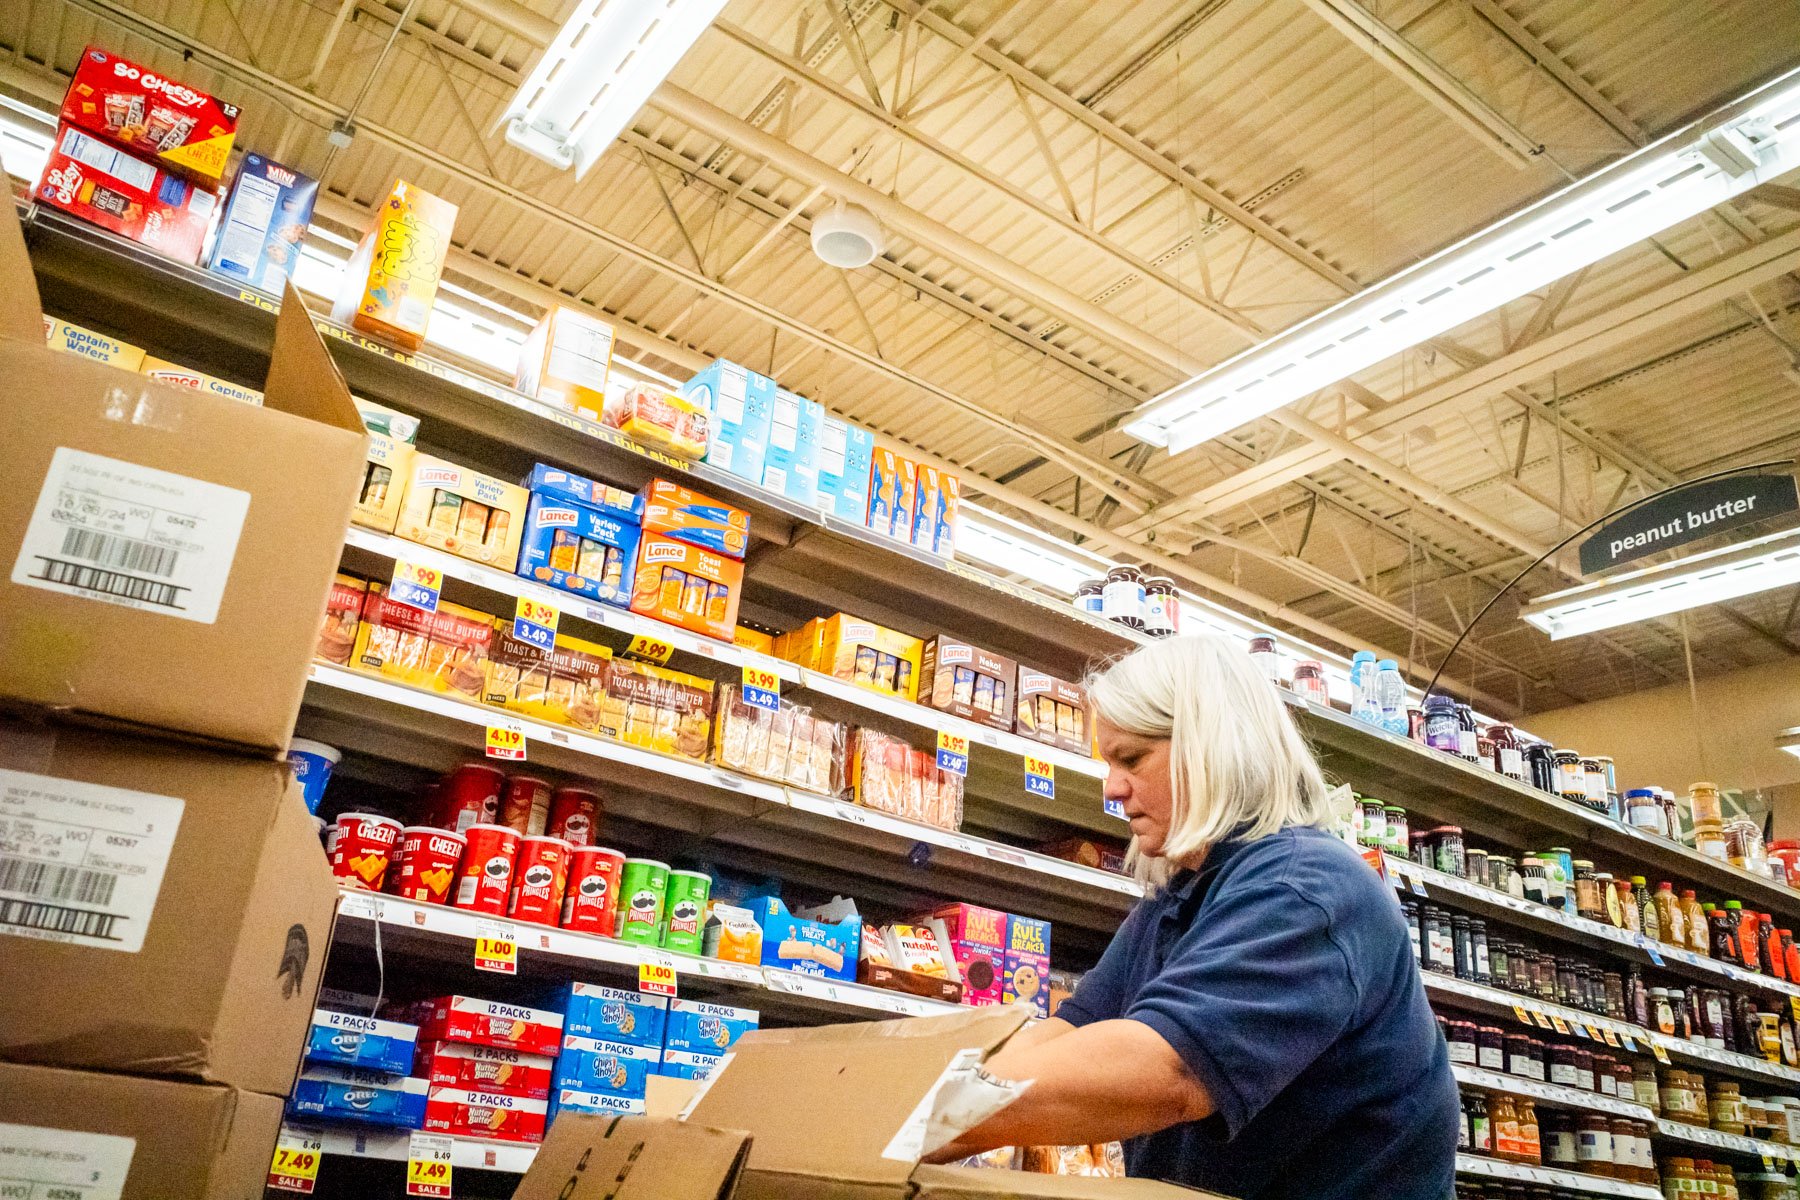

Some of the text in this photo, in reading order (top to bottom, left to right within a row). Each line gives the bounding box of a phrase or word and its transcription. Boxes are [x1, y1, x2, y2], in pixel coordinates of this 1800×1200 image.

[114, 62, 208, 109] SO CHEESY!
[223, 103, 238, 115] 12
[47, 168, 63, 186] SO
[238, 291, 390, 355] Plea ask for
[63, 326, 119, 354] Captain's
[66, 338, 109, 362] Wafers
[210, 381, 263, 406] Captain's
[587, 426, 689, 471] on this shelf
[417, 469, 459, 485] Lance
[474, 479, 504, 496] Variety
[477, 489, 498, 502] Pack
[129, 507, 151, 520] WO
[539, 511, 576, 523] Lance
[589, 514, 622, 533] Variety
[1610, 495, 1757, 559] peanut butter
[592, 525, 616, 540] Pack
[648, 545, 684, 559] Lance
[699, 552, 722, 568] Toast
[698, 562, 720, 576] Chee
[331, 593, 359, 609] UTTER
[398, 584, 430, 604] 3.49
[523, 601, 554, 625] 3.99
[379, 602, 488, 640] CHEESE & PEANUT BUTTER
[521, 623, 548, 644] 3.49
[845, 625, 875, 638] Lance
[635, 639, 667, 657] 3.99
[943, 647, 971, 660] Lance
[503, 641, 600, 675] TOAST & PEANUT BUTTER
[978, 656, 1002, 671] Nekot
[748, 670, 774, 689] 3.99
[1024, 677, 1050, 690] Lance
[612, 676, 704, 706] TOAST & PEANUT BUTTER
[749, 690, 773, 706] 3.49
[1058, 685, 1080, 700] Nekot
[491, 731, 520, 744] 4.19
[942, 734, 964, 751] 3.99
[942, 754, 962, 770] 3.49
[1028, 763, 1050, 776] 3.99
[1030, 777, 1049, 792] 3.49
[66, 829, 88, 842] WO
[481, 875, 507, 893] PRINGLES
[522, 886, 550, 900] PRINGLES
[577, 895, 605, 910] PRINGLES
[628, 910, 655, 925] PRINGLES
[728, 920, 756, 929] Goldfish
[966, 912, 998, 933] RULE
[670, 919, 698, 934] PRINGLES
[1012, 921, 1043, 942] RULE
[500, 932, 515, 941] 1.69
[801, 931, 826, 942] TREATS
[964, 929, 1001, 945] BREAKER
[481, 941, 511, 955] 1.00
[901, 940, 939, 952] nutella
[1011, 938, 1045, 954] BREAKER
[484, 960, 507, 970] SALE
[643, 966, 671, 979] 1.00
[647, 982, 668, 992] SALE
[601, 988, 642, 1003] 12 PACKS
[487, 1003, 531, 1020] 12 PACKS
[698, 1004, 735, 1017] 12 PACKS
[329, 1014, 377, 1031] 12 PACKS
[489, 1018, 512, 1029] Nutter
[488, 1025, 513, 1037] Butter
[331, 1034, 367, 1046] OREO
[473, 1049, 519, 1063] 12 PACKS
[594, 1041, 634, 1056] 12 PACKS
[692, 1055, 701, 1064] 12
[474, 1062, 499, 1073] Nutter
[474, 1069, 499, 1081] Butter
[341, 1070, 389, 1086] 12 PACKS
[343, 1091, 379, 1102] OREO
[467, 1093, 513, 1108] 12 PACKS
[590, 1095, 631, 1110] 12 PACKS
[467, 1114, 492, 1126] Butter
[468, 1107, 492, 1118] Nutter
[302, 1140, 321, 1152] 8.49
[276, 1150, 314, 1170] 7.49
[434, 1150, 451, 1161] 8.49
[414, 1161, 446, 1178] 7.49
[277, 1176, 303, 1189] SALE
[418, 1184, 441, 1194] SALE
